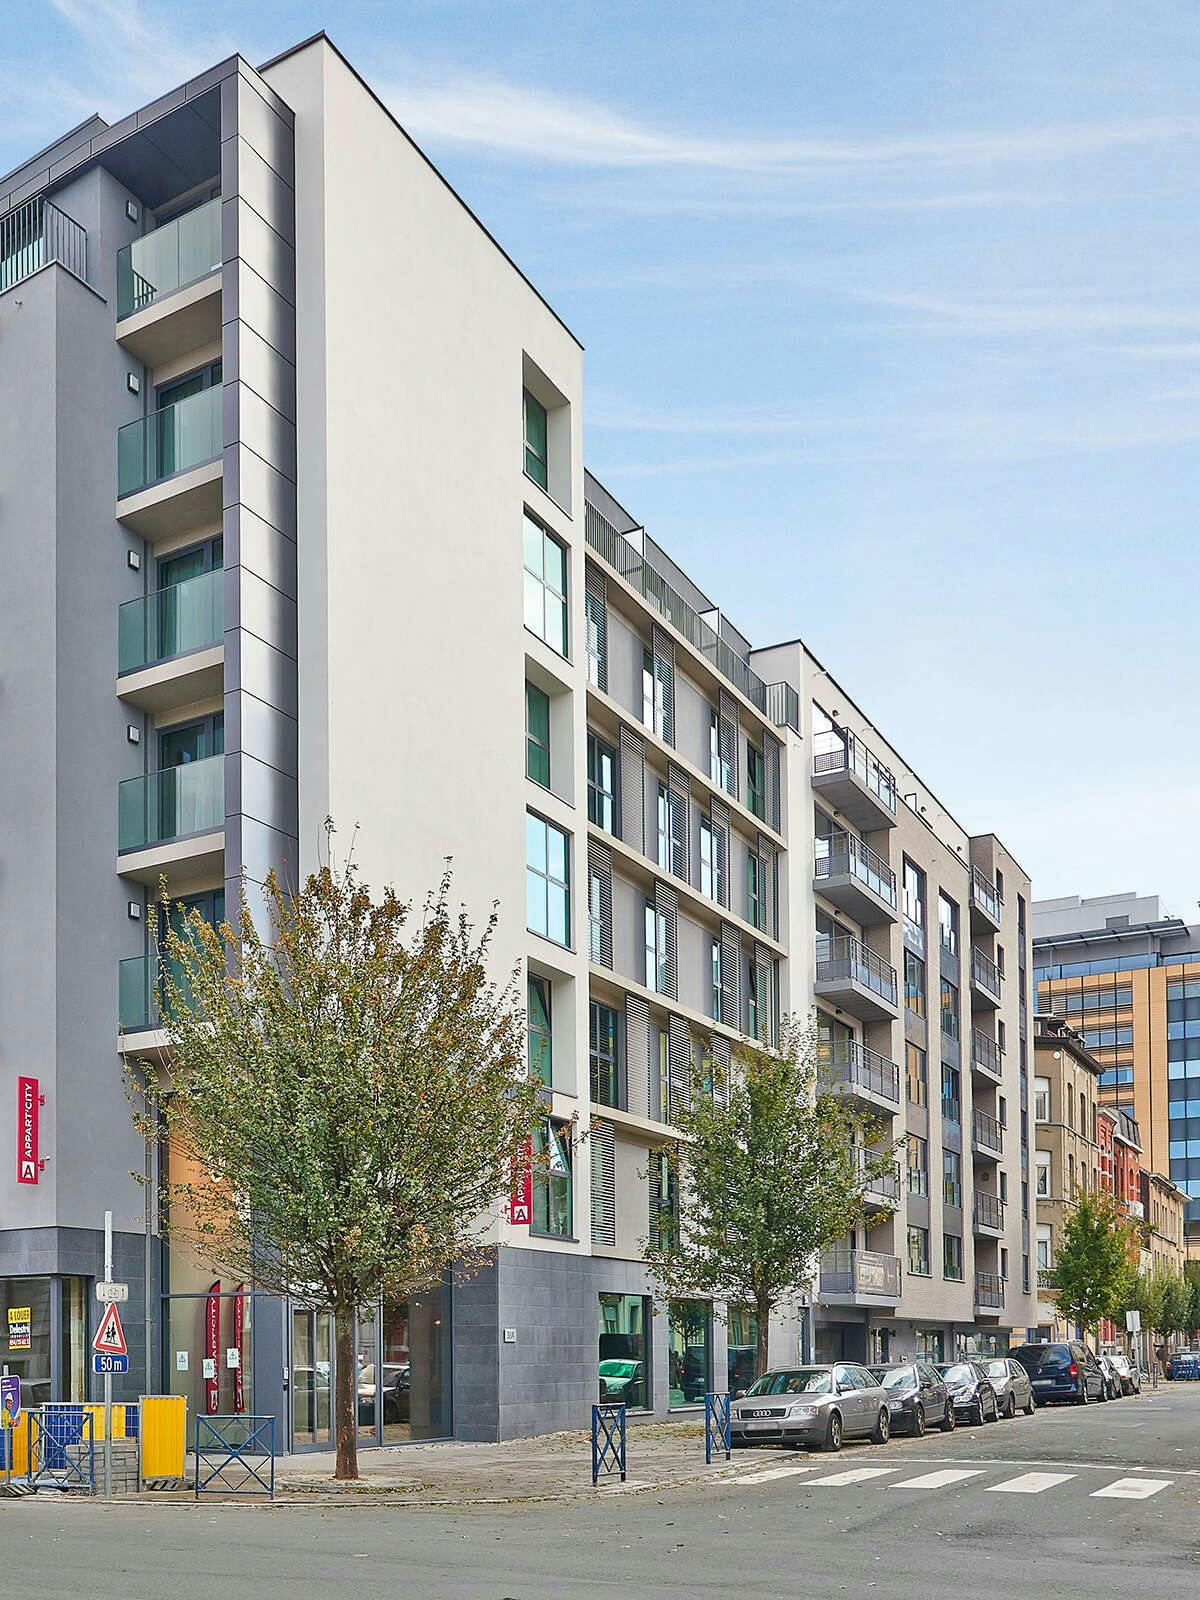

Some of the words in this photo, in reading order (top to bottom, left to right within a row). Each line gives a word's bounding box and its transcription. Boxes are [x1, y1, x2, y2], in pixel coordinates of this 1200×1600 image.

[24, 1083, 33, 1158] APPART'CITY
[100, 1357, 112, 1371] 50
[114, 1361, 122, 1371] m
